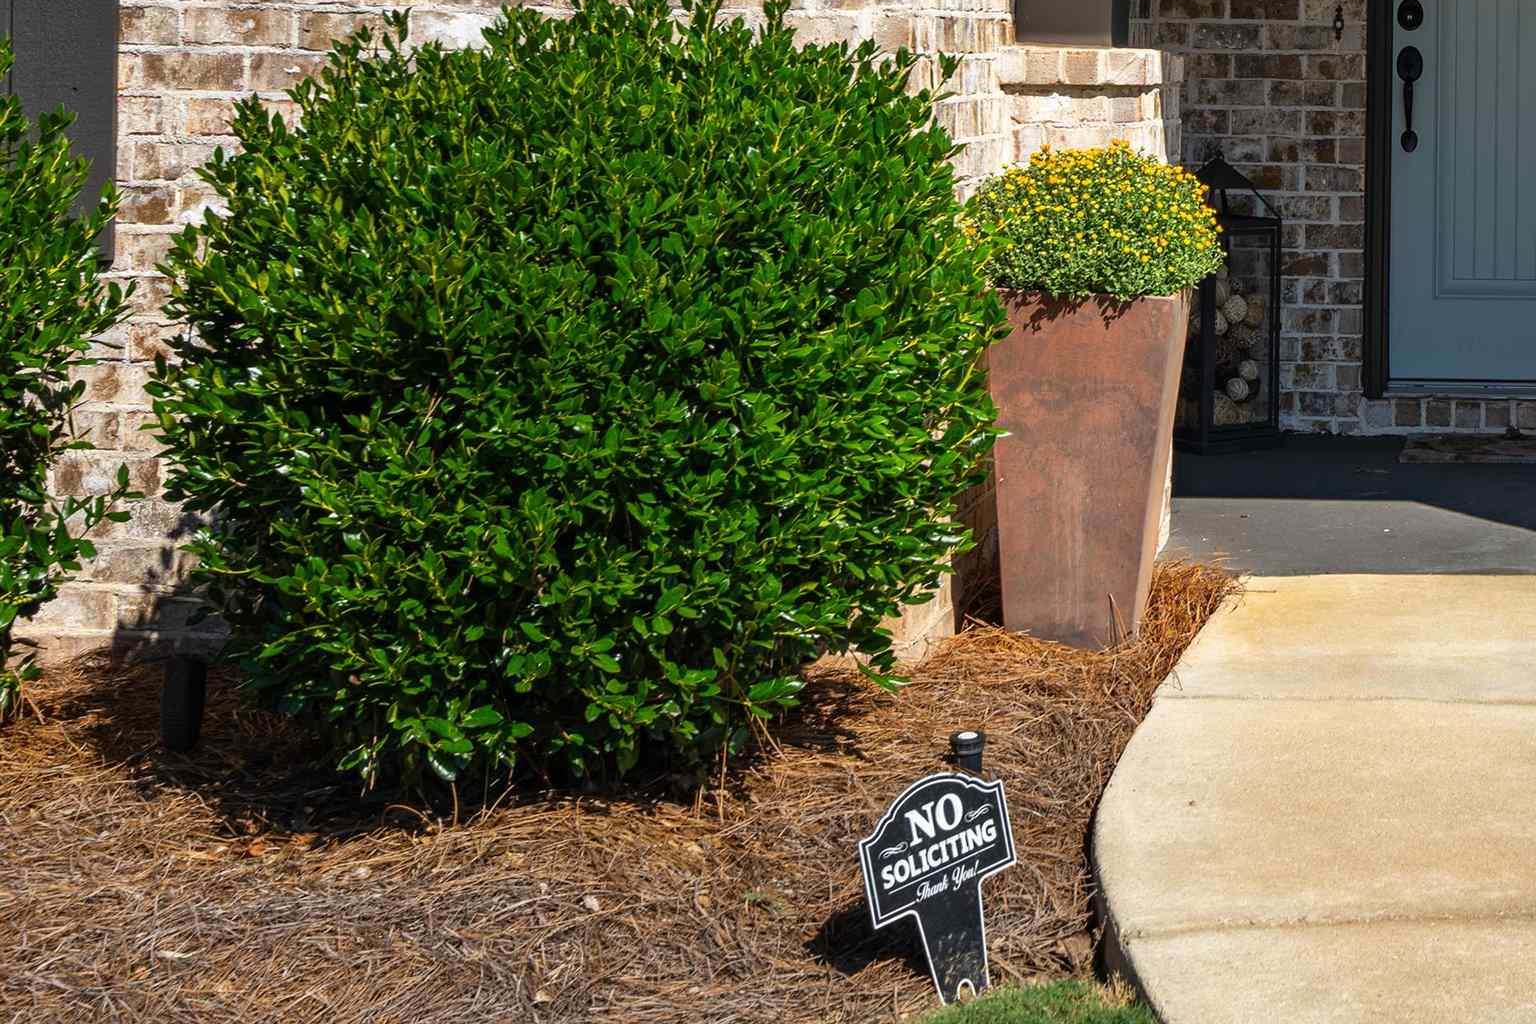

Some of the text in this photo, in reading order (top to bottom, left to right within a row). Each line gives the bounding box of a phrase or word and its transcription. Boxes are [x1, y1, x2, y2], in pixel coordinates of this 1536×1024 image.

[905, 793, 964, 846] NO
[881, 819, 997, 890] SOLICITING
[916, 860, 979, 903] Thank You!
